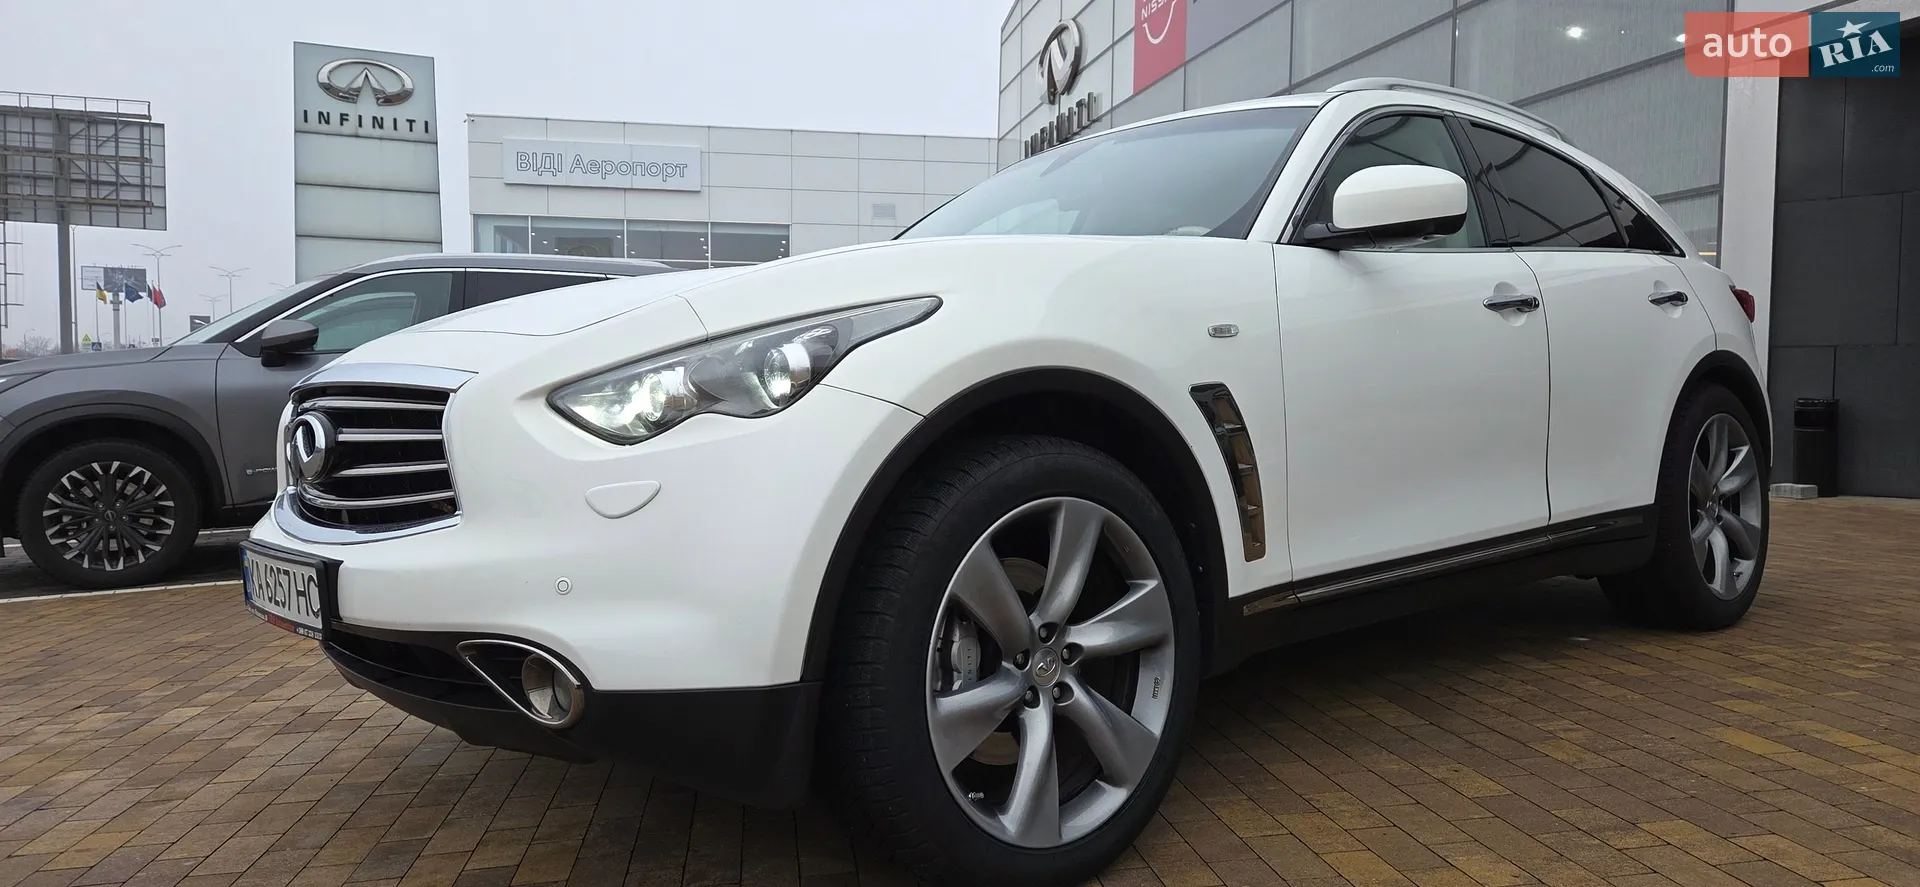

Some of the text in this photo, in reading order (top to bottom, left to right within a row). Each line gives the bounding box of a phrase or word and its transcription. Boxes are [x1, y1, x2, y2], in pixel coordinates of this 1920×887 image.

[1141, 0, 1166, 20] NISS
[303, 109, 429, 134] INFINITI
[516, 151, 688, 183] ВІДІ Аеропорт
